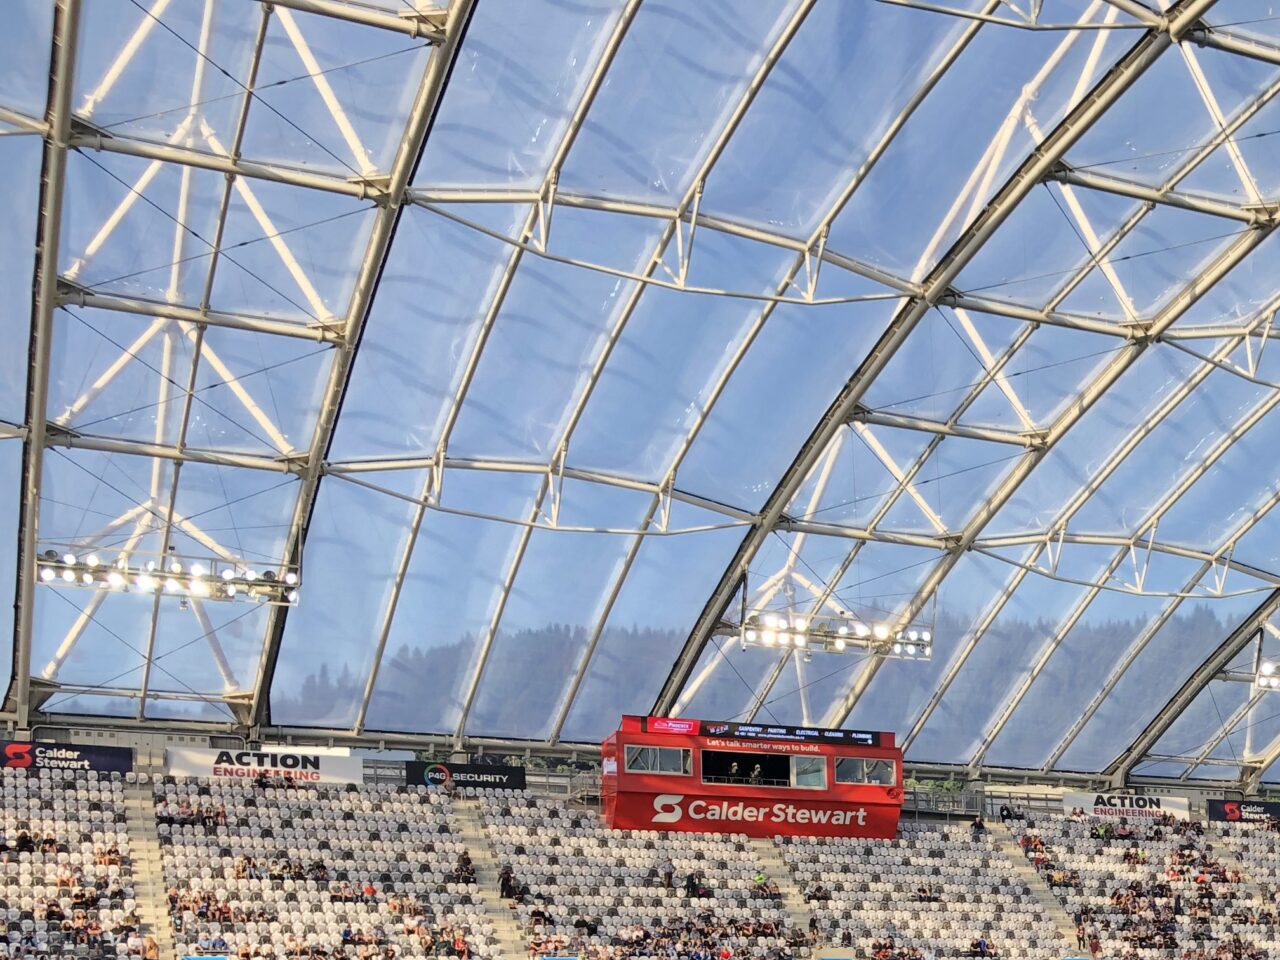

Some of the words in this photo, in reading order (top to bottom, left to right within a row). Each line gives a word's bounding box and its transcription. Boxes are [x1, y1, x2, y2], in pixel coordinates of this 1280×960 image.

[742, 741, 771, 749] smarter
[772, 744, 790, 752] ways
[36, 747, 81, 759] Calder
[36, 757, 90, 769] Stewart
[214, 751, 320, 770] ACTION
[428, 772, 446, 780] P4G
[452, 773, 509, 783] SECURITY
[1094, 795, 1161, 809] ACTION
[688, 800, 770, 822] Calder
[771, 803, 867, 825] Stewart
[1094, 807, 1162, 818] ENGINEERING
[1241, 804, 1265, 813] Calder
[1241, 811, 1270, 819] Stewart
